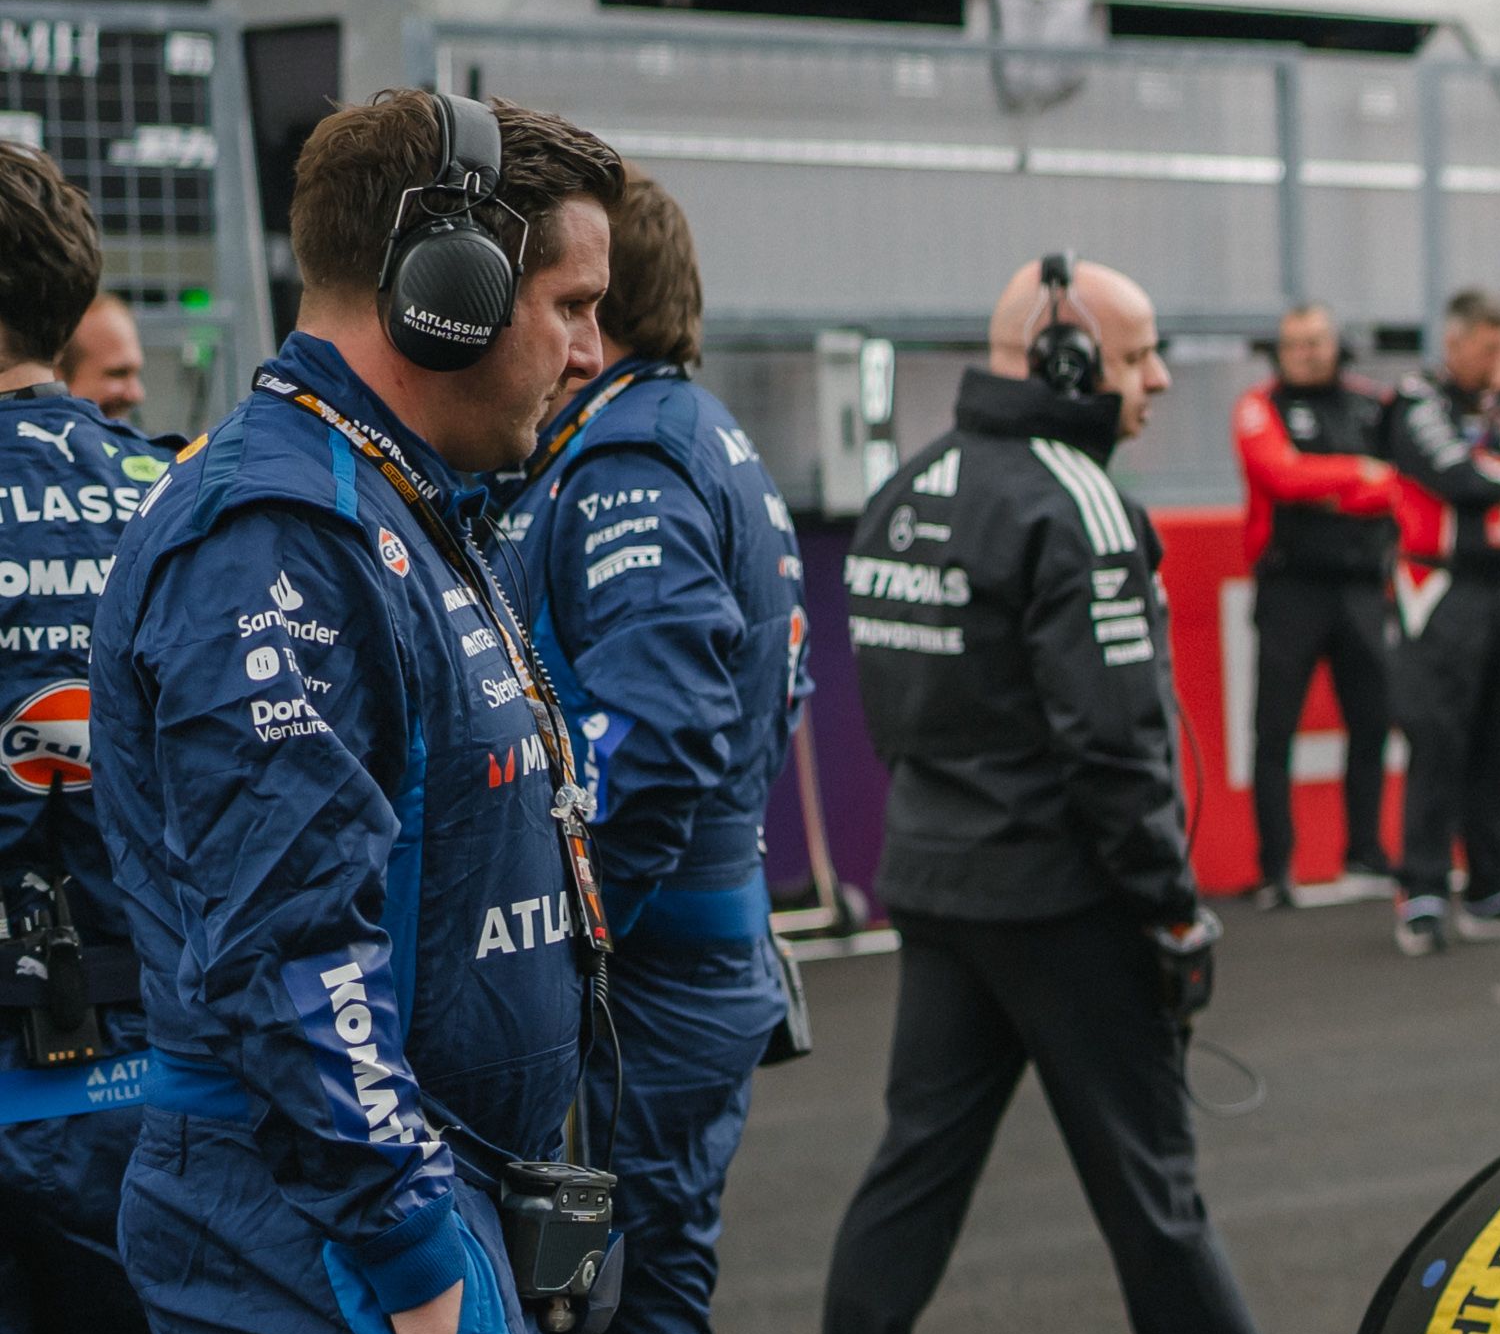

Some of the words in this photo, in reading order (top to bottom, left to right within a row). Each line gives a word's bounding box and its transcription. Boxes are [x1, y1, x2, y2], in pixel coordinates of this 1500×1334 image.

[403, 315, 453, 340] WILLIAMS
[453, 334, 487, 345] RACING
[416, 310, 492, 336] ATLASSIAN
[601, 489, 661, 510] VAST
[596, 517, 659, 544] KEEPER
[587, 545, 662, 590] PIRELLI
[237, 607, 340, 646] Sannder
[255, 720, 333, 743] Venture
